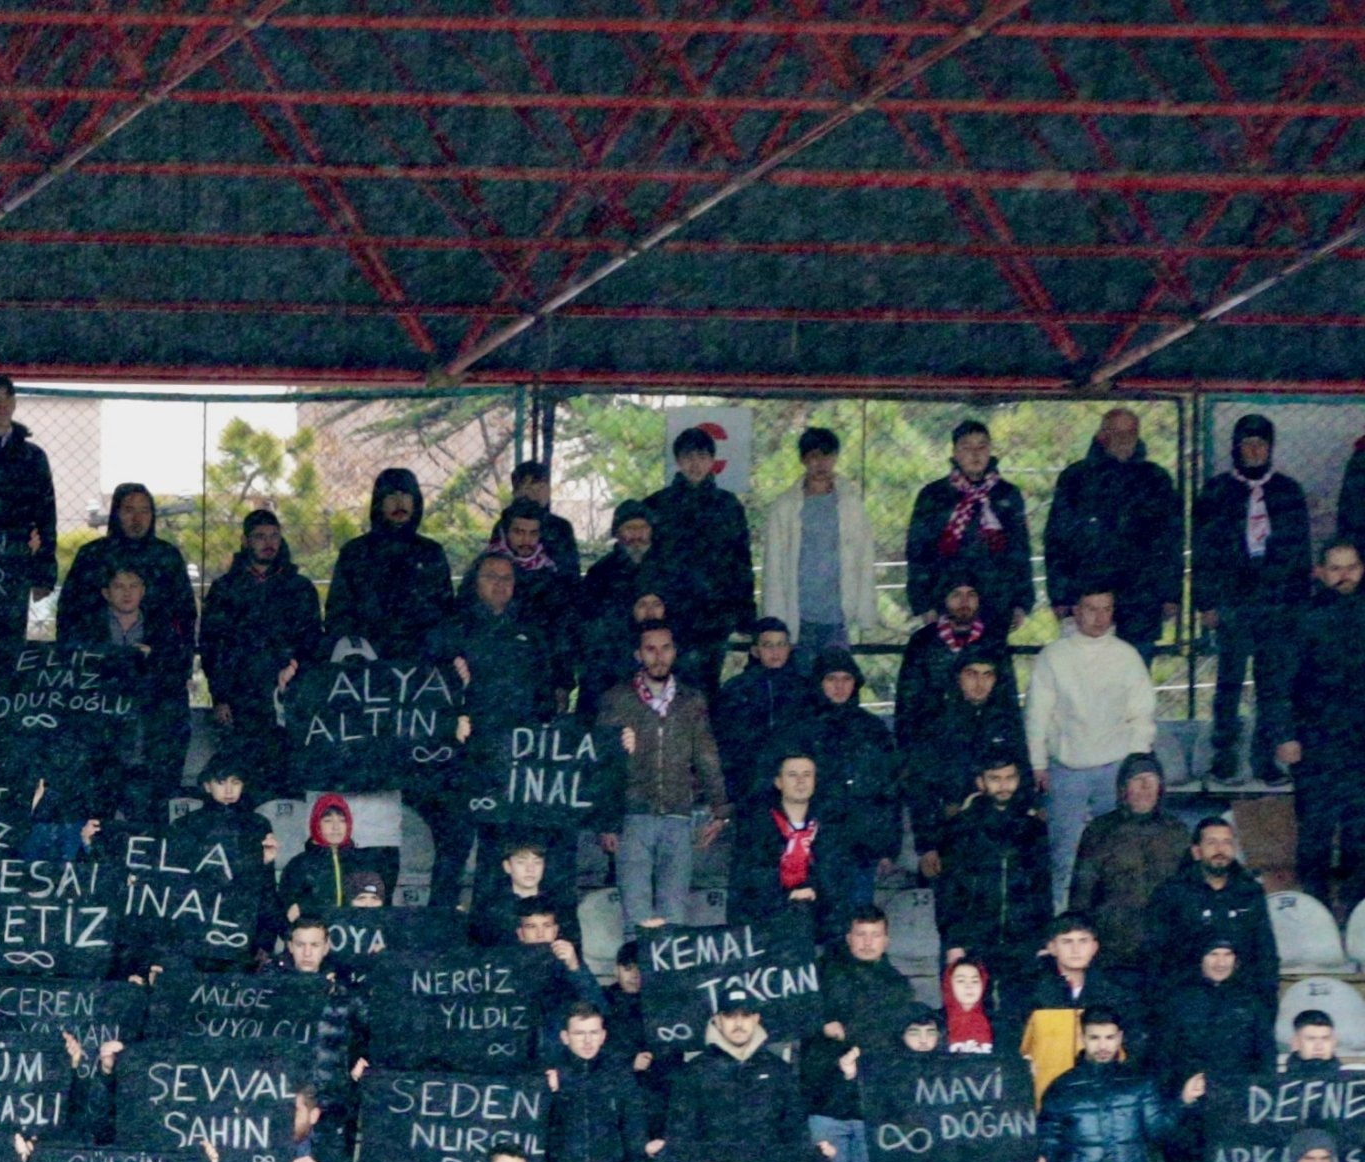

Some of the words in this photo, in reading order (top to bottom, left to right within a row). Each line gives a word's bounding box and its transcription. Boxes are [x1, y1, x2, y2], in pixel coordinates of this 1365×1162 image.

[327, 665, 454, 706] ALYA
[304, 705, 438, 747] ALTIN
[511, 723, 599, 762] DİLA
[507, 761, 594, 809] İNAL
[125, 834, 234, 882] ELA
[123, 874, 240, 929] İNAL
[649, 924, 766, 974] KEMAL
[410, 963, 517, 997] NERGİZ
[440, 1004, 530, 1032] YILDIZ
[387, 1079, 543, 1122] SEDEN
[916, 1068, 1003, 1103] MAVİ
[941, 1104, 1037, 1141] DOĞAN
